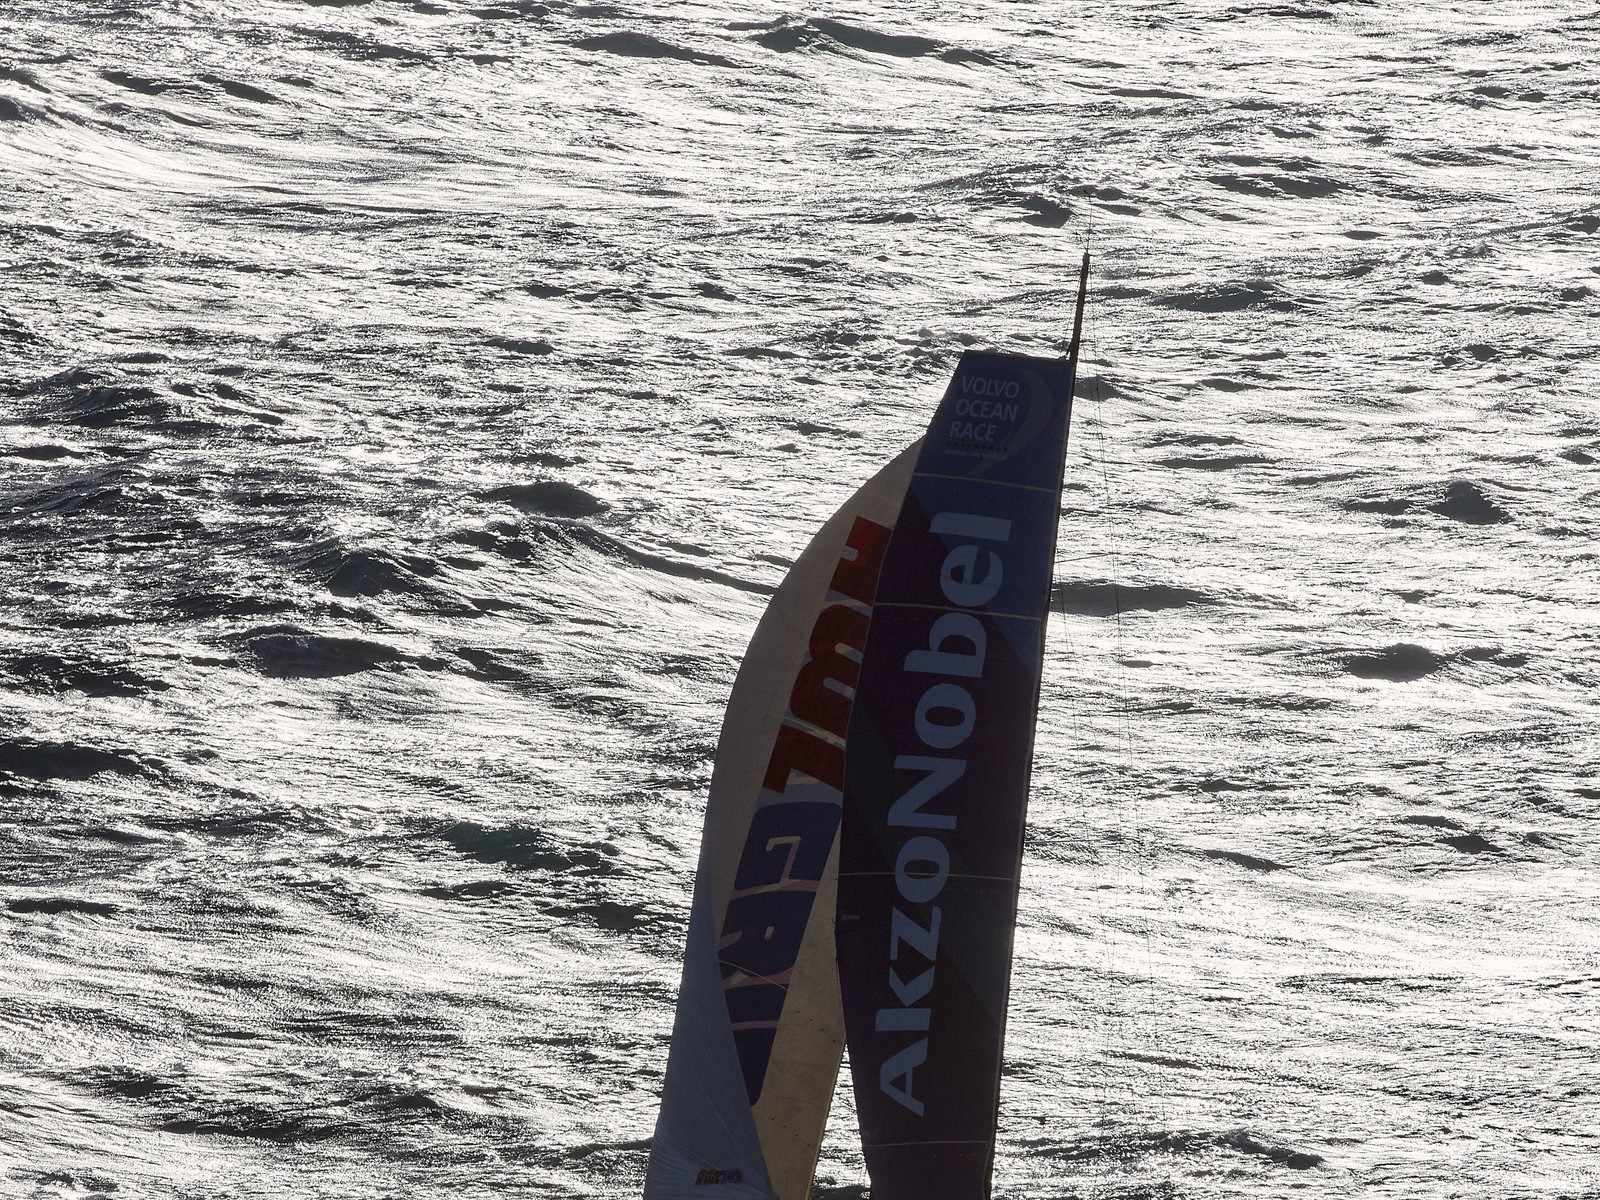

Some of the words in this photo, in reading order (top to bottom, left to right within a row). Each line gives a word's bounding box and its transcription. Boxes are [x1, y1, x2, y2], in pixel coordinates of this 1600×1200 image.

[961, 375, 1020, 399] VOLVO
[955, 399, 1018, 422] OCEAN
[950, 420, 998, 442] RACE
[875, 510, 1012, 1117] AkzoNobel
